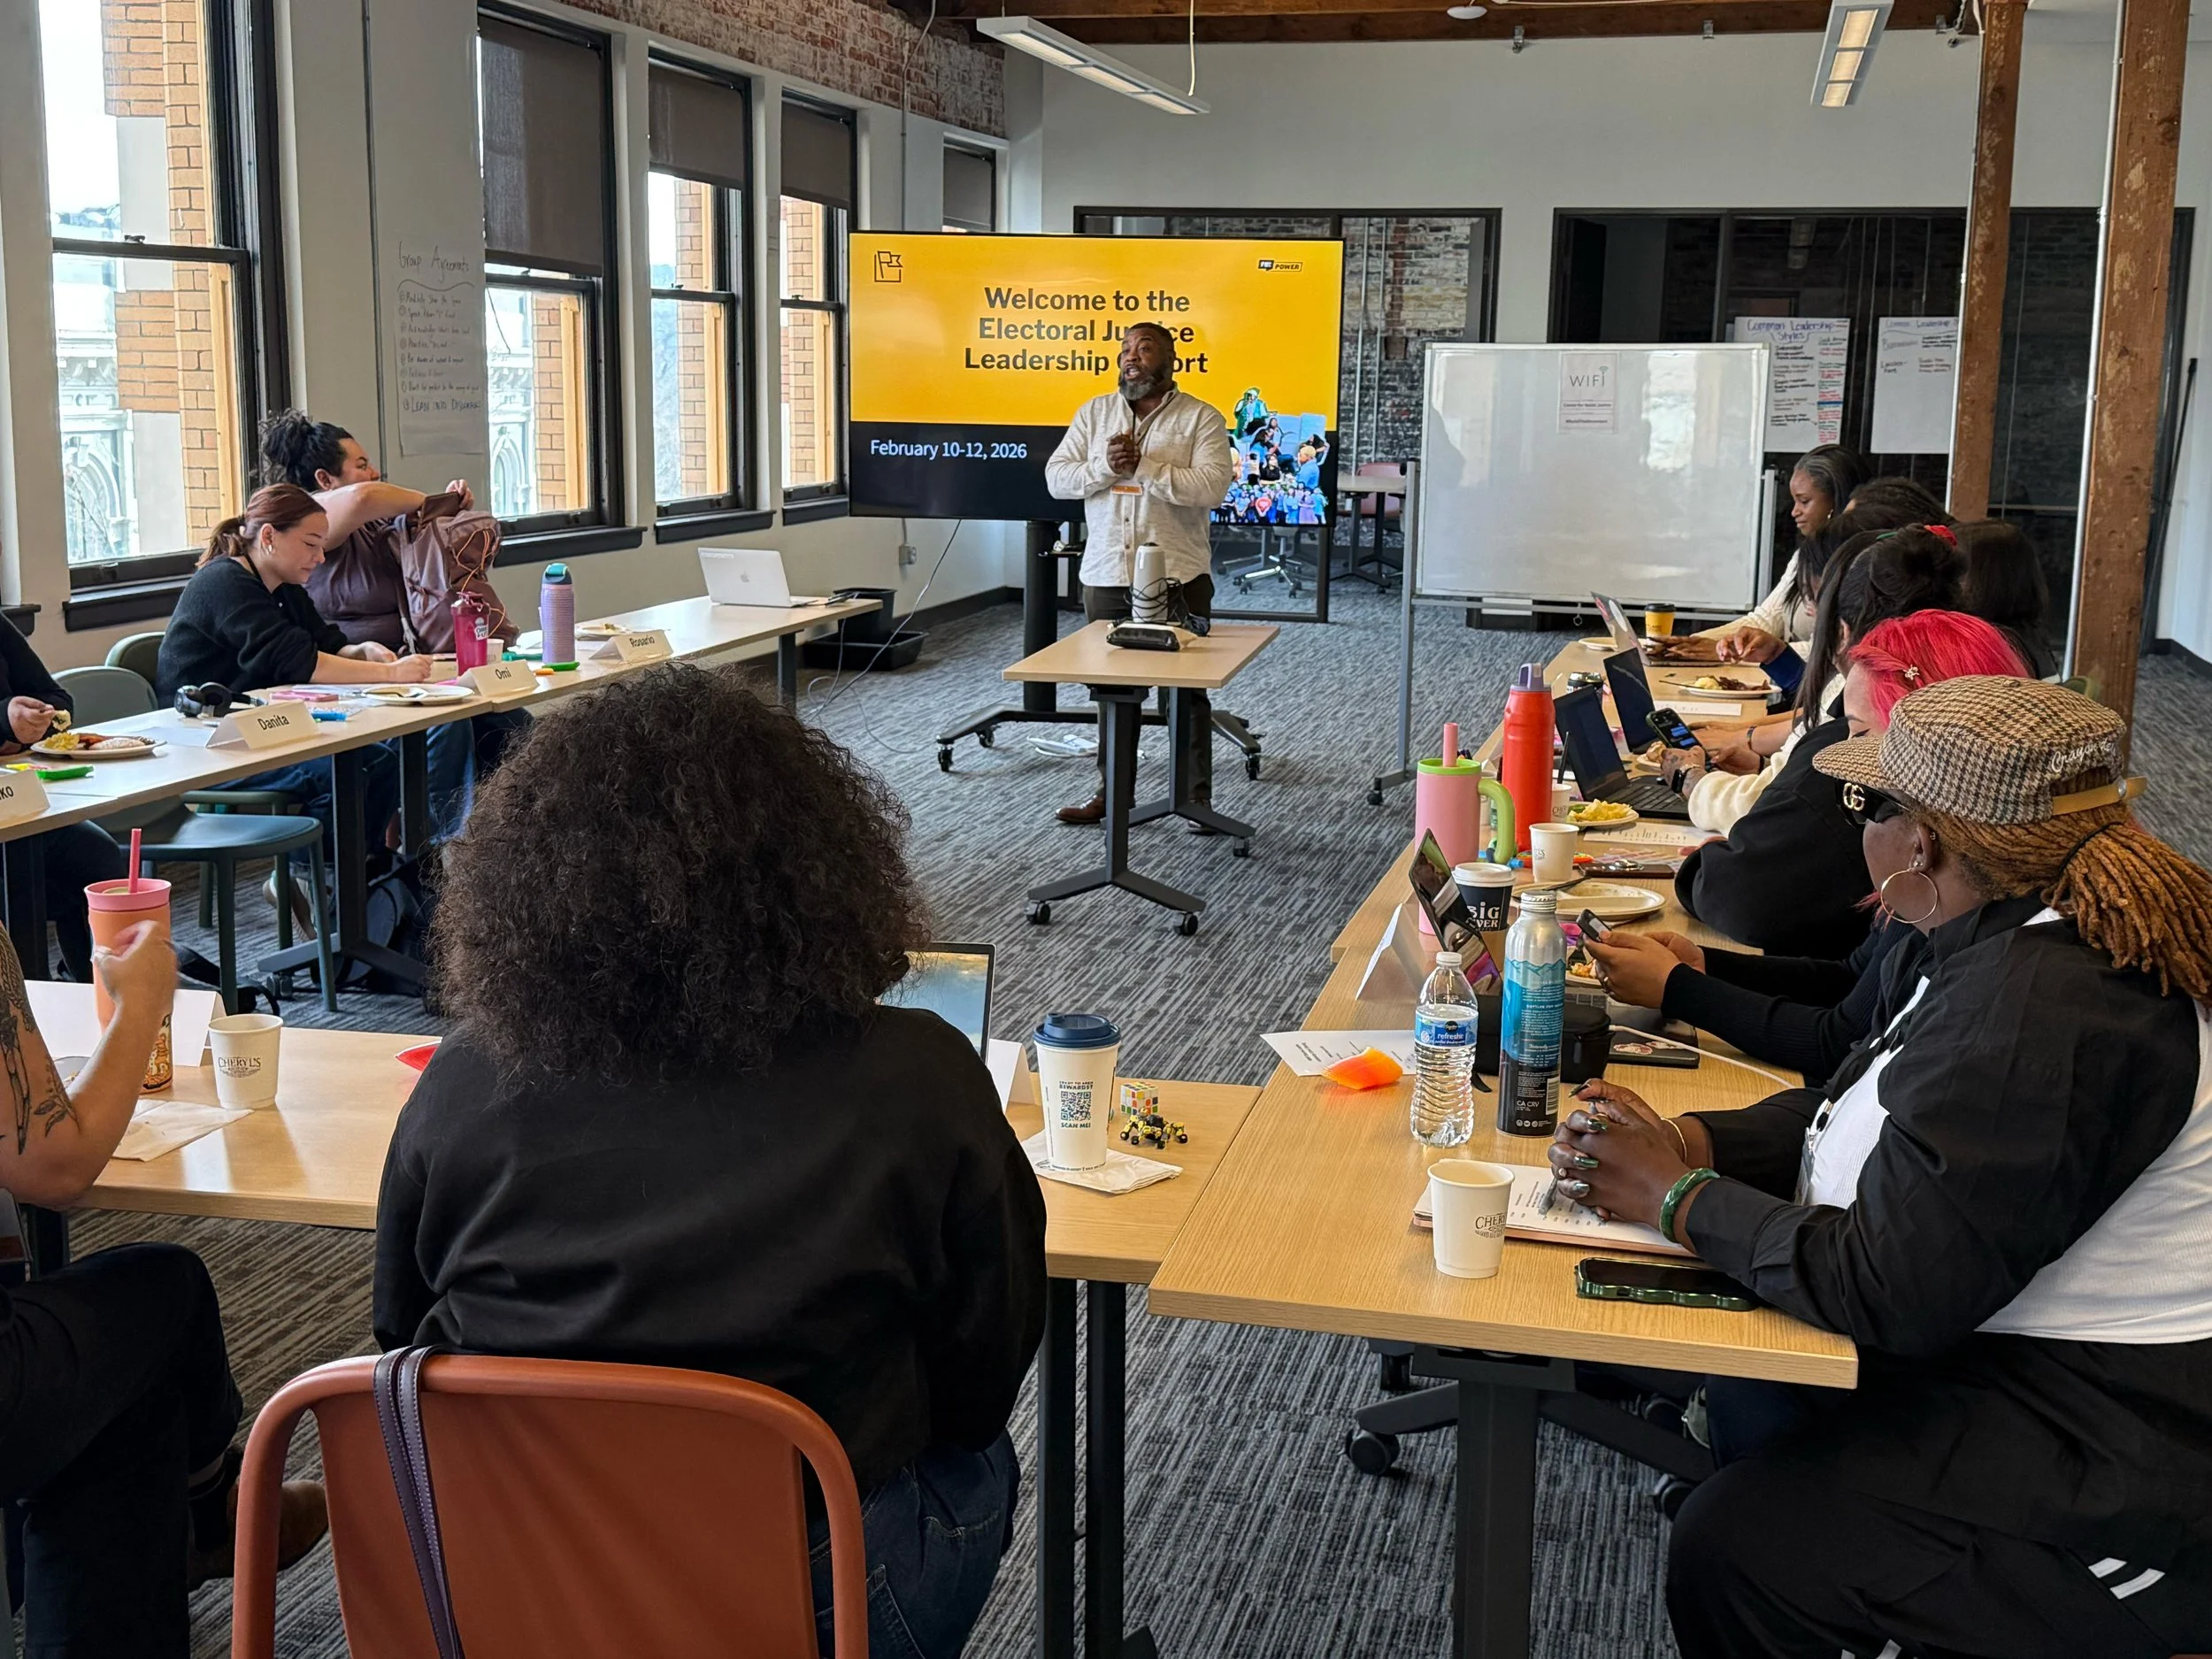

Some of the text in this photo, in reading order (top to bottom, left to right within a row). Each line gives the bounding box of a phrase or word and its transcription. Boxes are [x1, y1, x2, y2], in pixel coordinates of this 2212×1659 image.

[984, 288, 1190, 312] Welcome to the
[979, 317, 1194, 342] Electoral Juce
[965, 348, 1109, 375] Leadership
[871, 440, 1027, 460] February 10-12, 2026
[495, 667, 511, 680] Omi
[257, 715, 289, 730] Danita
[0, 786, 14, 800] KO
[219, 1057, 261, 1067] CHERYL'S
